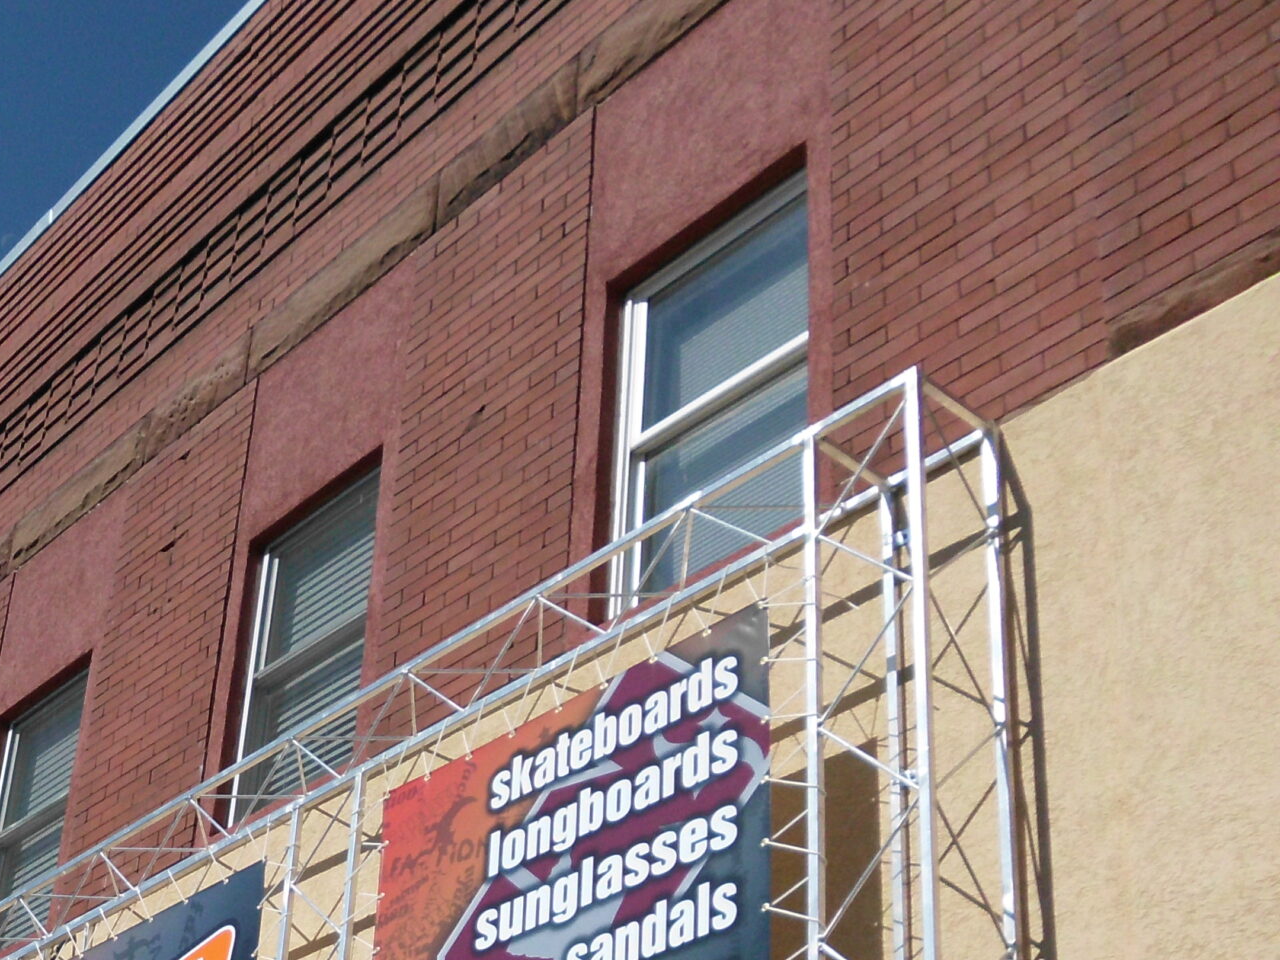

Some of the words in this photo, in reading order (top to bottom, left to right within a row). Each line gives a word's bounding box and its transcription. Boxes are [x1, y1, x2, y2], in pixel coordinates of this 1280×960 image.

[487, 728, 739, 878] longboards
[490, 653, 739, 810] skateboards
[474, 804, 739, 951] sunglasses
